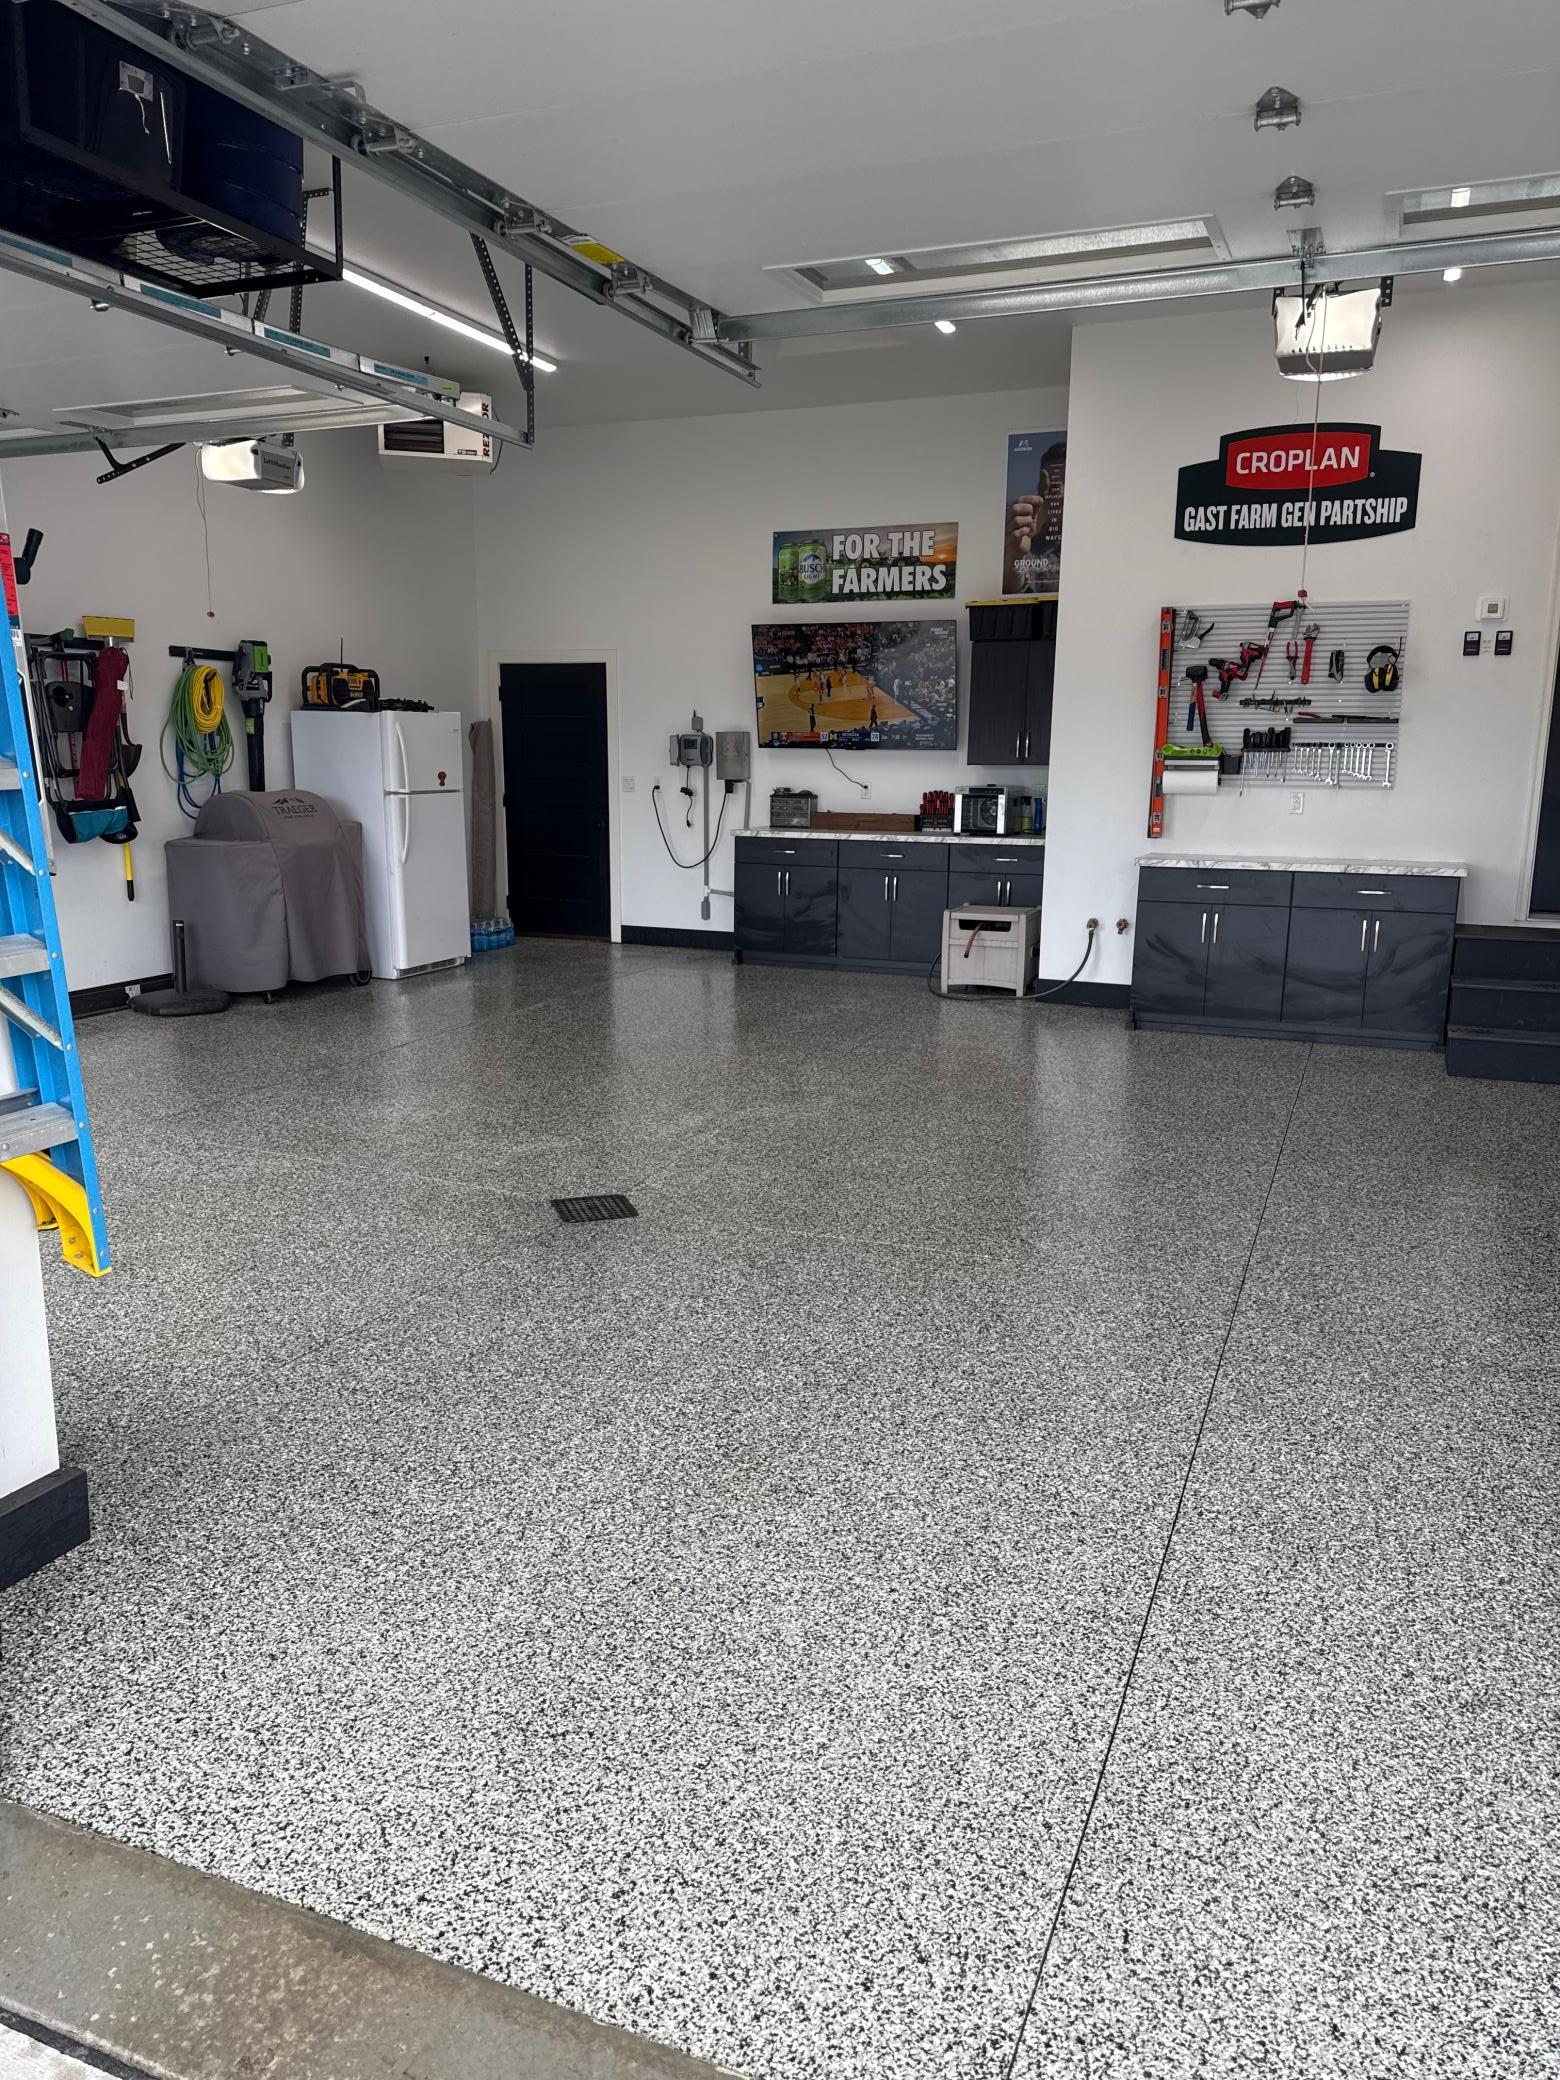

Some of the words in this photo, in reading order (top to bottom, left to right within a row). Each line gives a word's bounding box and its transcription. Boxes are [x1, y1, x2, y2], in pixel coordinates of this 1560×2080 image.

[1236, 446, 1360, 475] CROPLAN
[1184, 505, 1228, 532] GAST
[1230, 502, 1277, 530] FARM
[1281, 499, 1316, 528] GEN
[1319, 496, 1409, 526] PARTSHIP
[832, 533, 881, 560] FOR
[888, 530, 935, 558] THE
[1014, 558, 1049, 568] GROUND
[831, 564, 947, 594] FARMERS
[272, 804, 318, 815] TRAEGER
